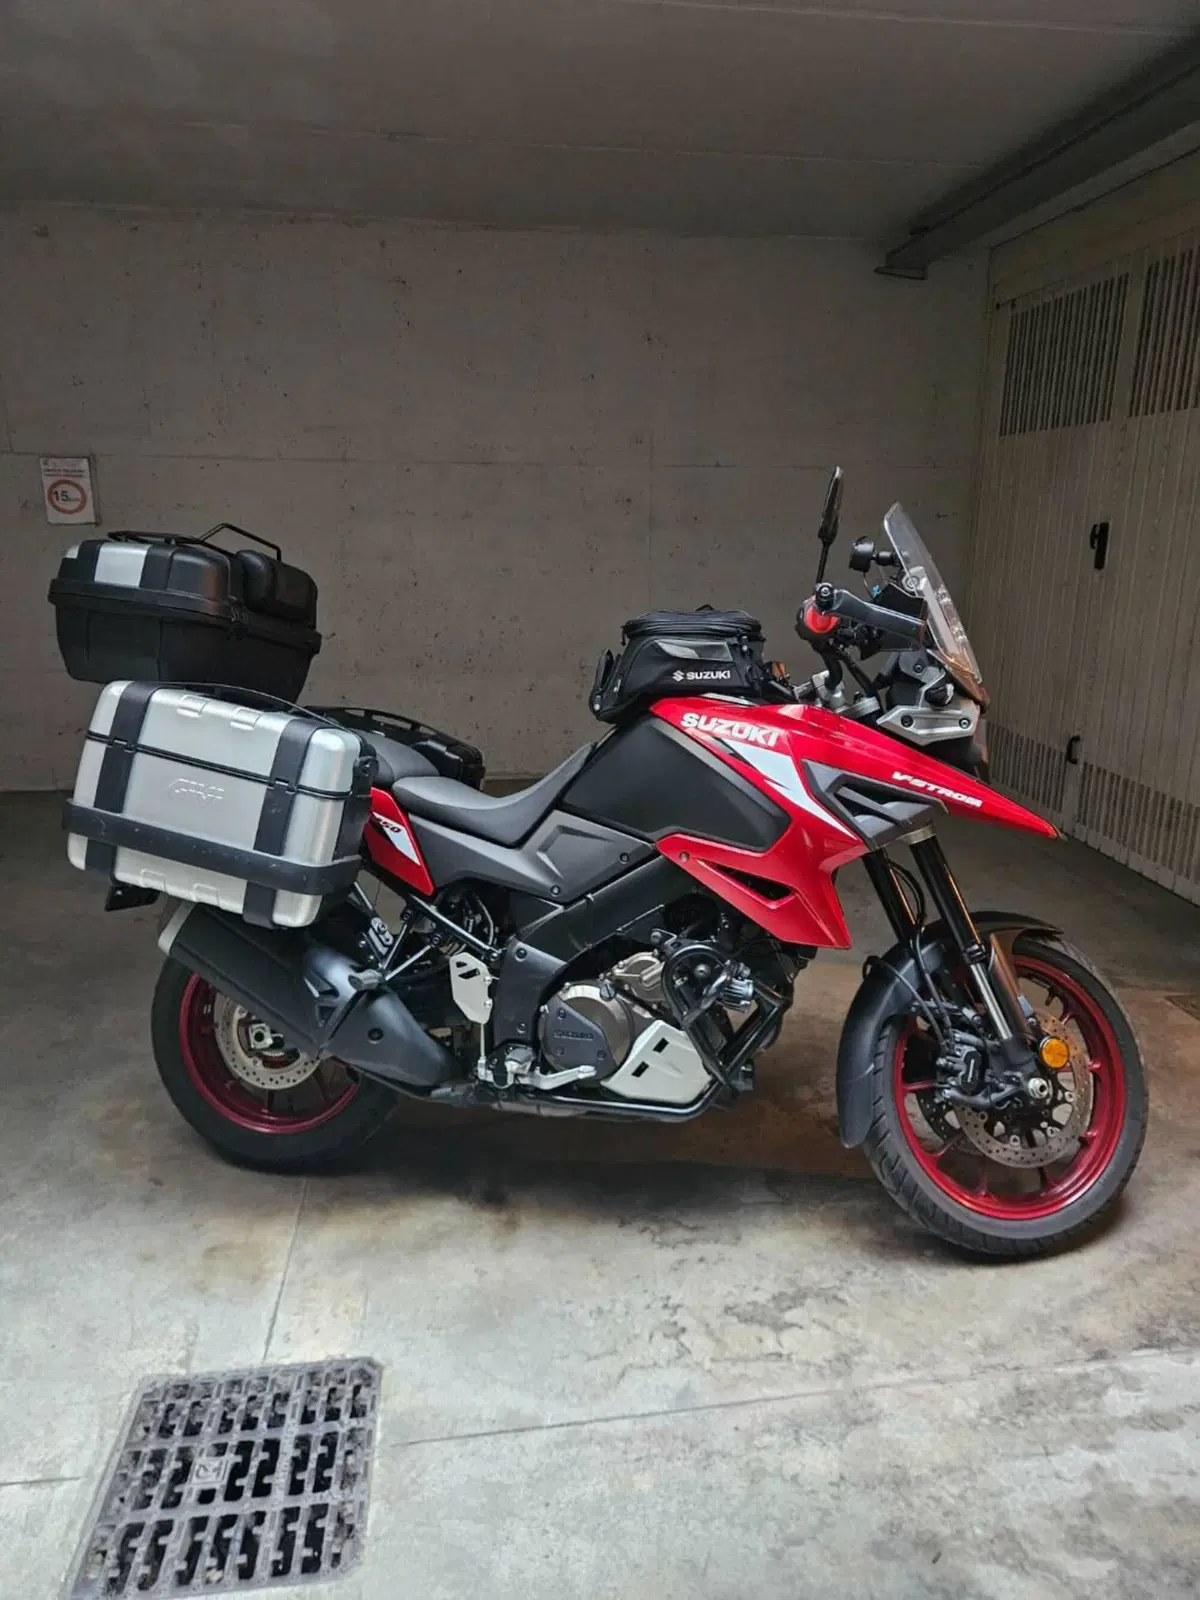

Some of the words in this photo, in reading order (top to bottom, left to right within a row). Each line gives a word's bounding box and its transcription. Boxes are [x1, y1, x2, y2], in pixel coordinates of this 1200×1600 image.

[52, 490, 69, 502] 15
[686, 670, 731, 680] SUZUKI
[680, 712, 779, 747] SUZUKI
